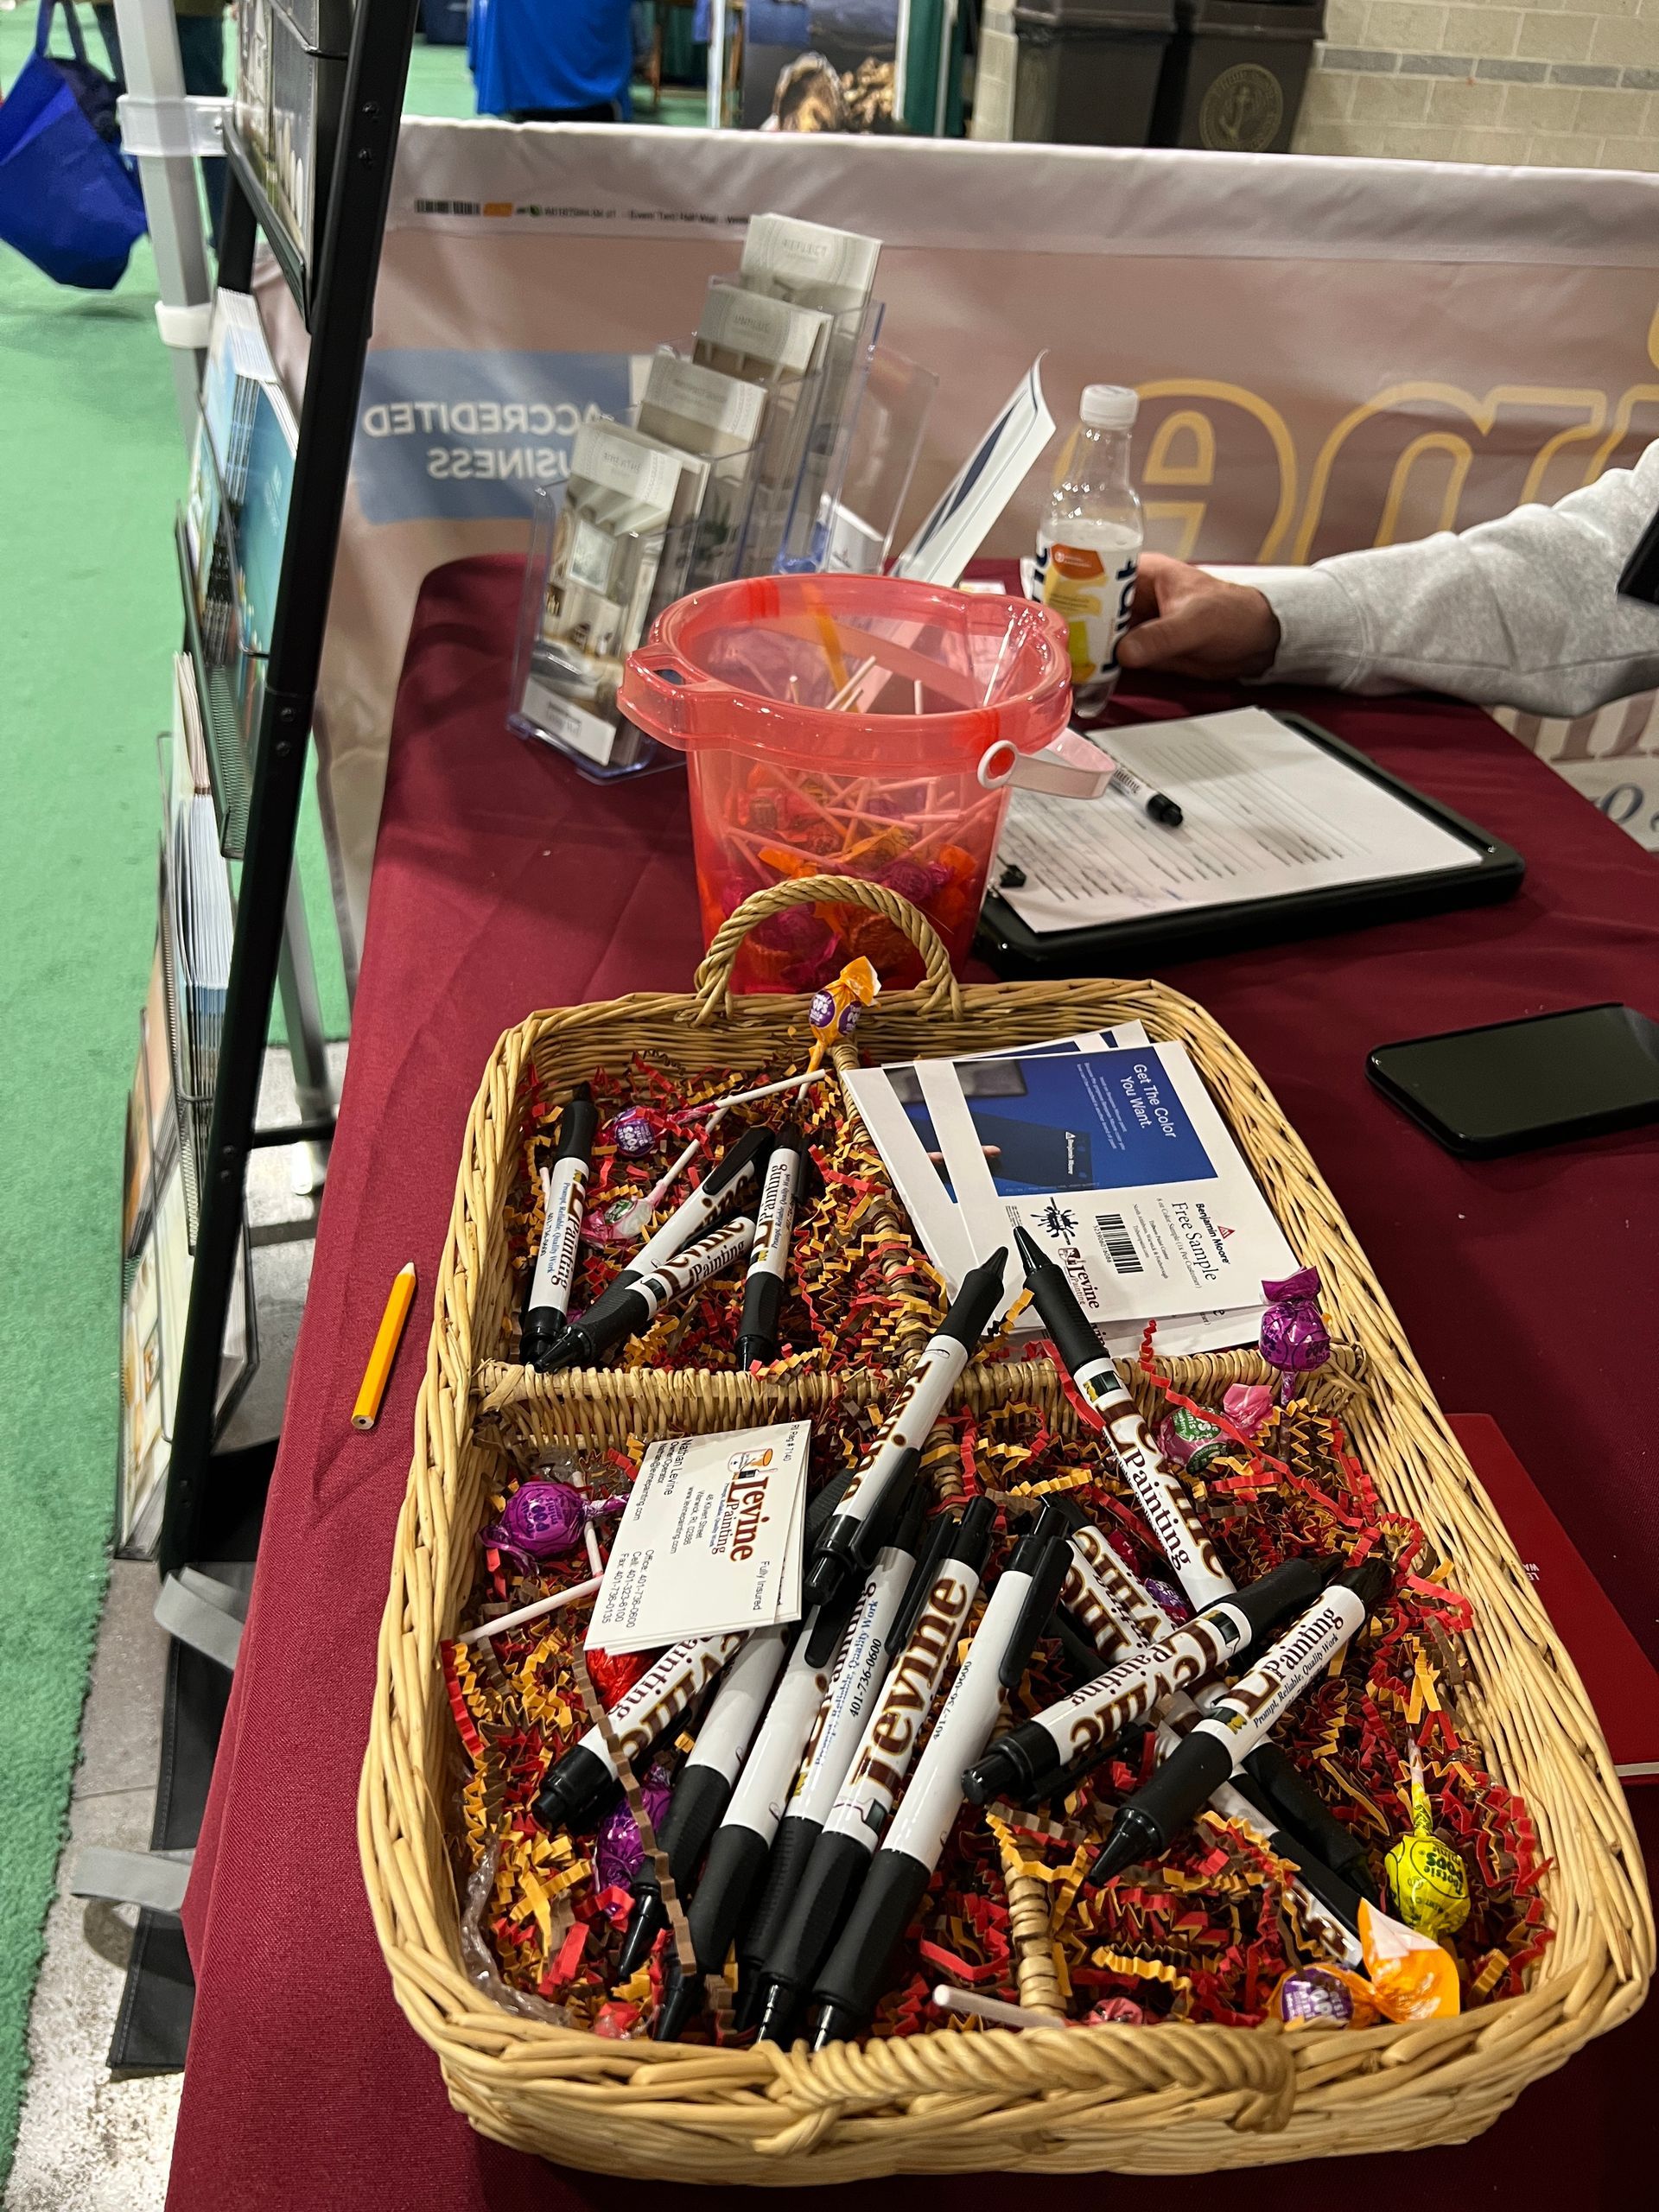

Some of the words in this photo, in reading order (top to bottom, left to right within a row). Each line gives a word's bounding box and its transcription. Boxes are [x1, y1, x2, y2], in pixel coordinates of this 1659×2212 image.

[1121, 1076, 1137, 1096] You
[1129, 1097, 1153, 1128] Want.
[1134, 1064, 1152, 1084] Get
[1144, 1085, 1160, 1105] The
[1154, 1108, 1177, 1138] Color
[622, 1125, 639, 1152] POPS
[760, 1163, 788, 1223] Painting
[550, 1231, 562, 1255] Quality
[550, 1215, 581, 1291] Painting
[691, 1240, 745, 1282] Painting
[1168, 1223, 1179, 1243] Sample
[1180, 1251, 1189, 1261] Per
[1185, 1260, 1202, 1288] Customer)
[1172, 1202, 1193, 1230] Free
[1185, 1232, 1219, 1281] Sample
[1195, 1203, 1217, 1237] Benjamin
[1212, 1238, 1230, 1264] Moore
[547, 1255, 558, 1274] Work
[1067, 1264, 1100, 1309] Levine
[675, 1439, 694, 1467] Nathan
[782, 1446, 794, 1462] 7140
[785, 1430, 798, 1444] Reg
[664, 1467, 683, 1496] Levine
[696, 1519, 709, 1539] Street
[711, 1502, 740, 1555] Painting
[727, 1476, 770, 1562] Levine
[1122, 1448, 1192, 1572] Painting
[601, 1569, 624, 1624] 401-736-0135
[614, 1568, 636, 1623] 401-323-6100
[753, 1580, 766, 1611] Insured
[756, 1560, 770, 1579] Fully
[626, 1573, 647, 1629] 401-736-0600
[847, 1633, 870, 1670] Quality
[861, 1599, 880, 1632] Work
[1262, 1607, 1344, 1682] Painting
[607, 1636, 699, 1722] ainting
[848, 1638, 882, 1719] 401-736-0600
[849, 1577, 968, 1799] Levine
[1065, 1643, 1173, 1706] Painting
[1253, 1702, 1280, 1728] Prompt,
[1277, 1673, 1305, 1702] Reliable,
[1302, 1651, 1324, 1675] Quality
[1322, 1632, 1339, 1654] Work
[1423, 1866, 1464, 1896] Tootsie
[1426, 1852, 1464, 1883] POPS
